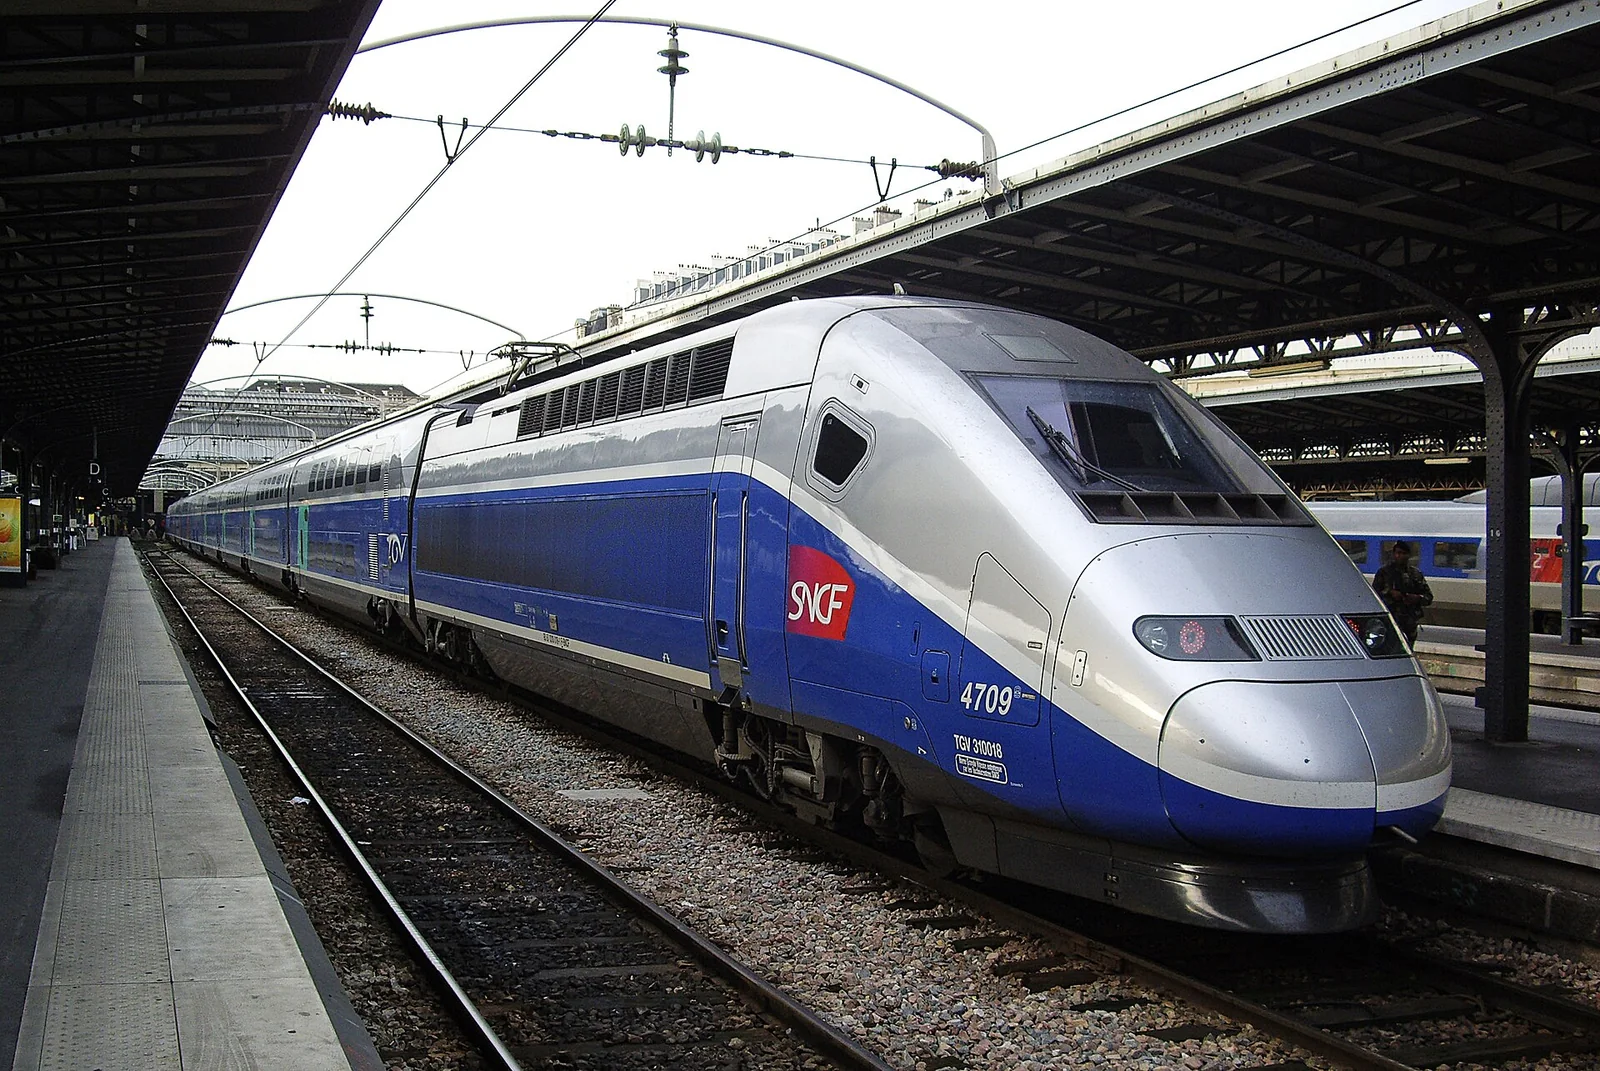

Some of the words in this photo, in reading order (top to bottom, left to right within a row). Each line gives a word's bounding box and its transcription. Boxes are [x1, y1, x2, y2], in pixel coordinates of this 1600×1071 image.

[90, 463, 100, 475] D
[387, 533, 407, 564] TGV
[787, 581, 849, 625] SNCF
[960, 682, 1013, 716] 4709
[953, 734, 971, 752] TGV
[972, 738, 1003, 759] 310018
